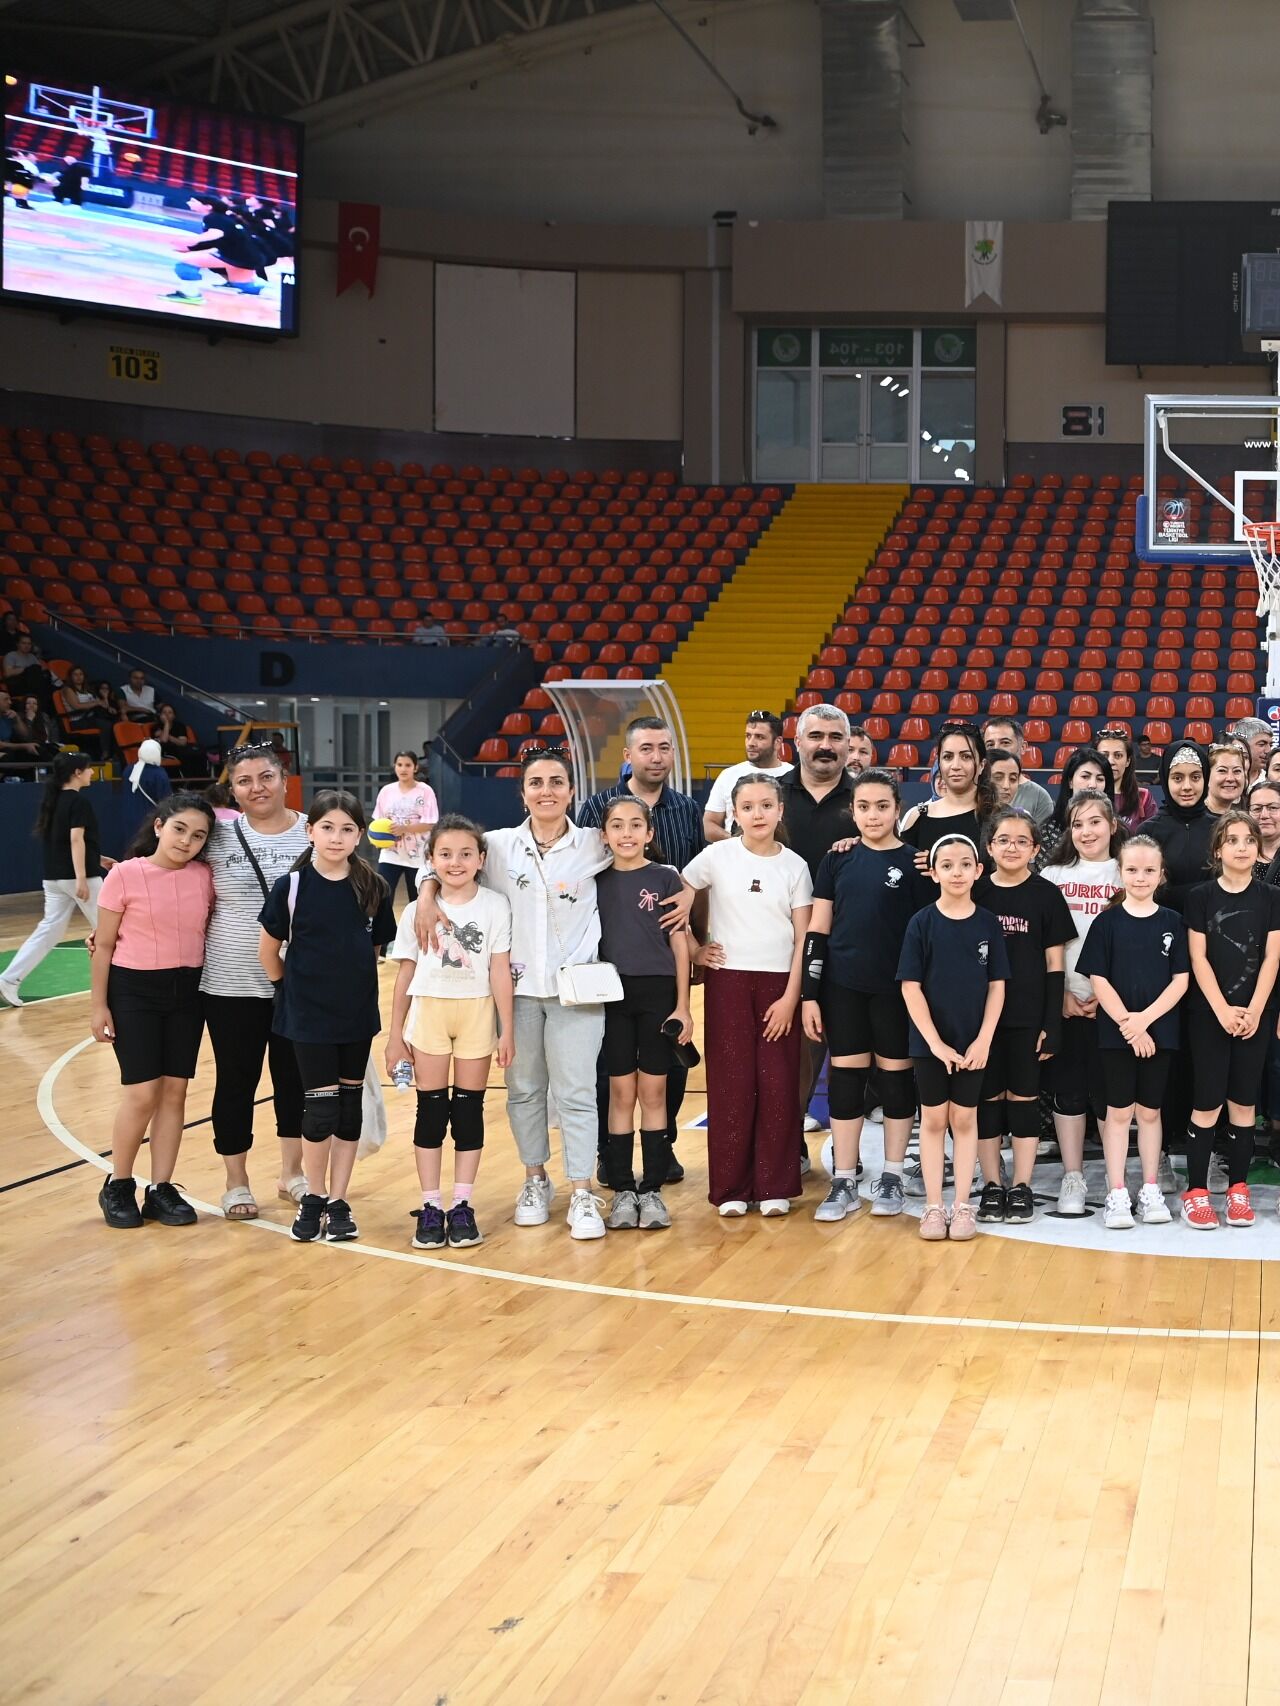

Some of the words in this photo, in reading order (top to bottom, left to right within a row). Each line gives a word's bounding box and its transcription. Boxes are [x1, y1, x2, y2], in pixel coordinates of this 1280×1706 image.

[112, 355, 158, 380] 103
[260, 651, 296, 687] D
[1057, 882, 1121, 898] TÜRKİY
[1084, 902, 1099, 915] 10
